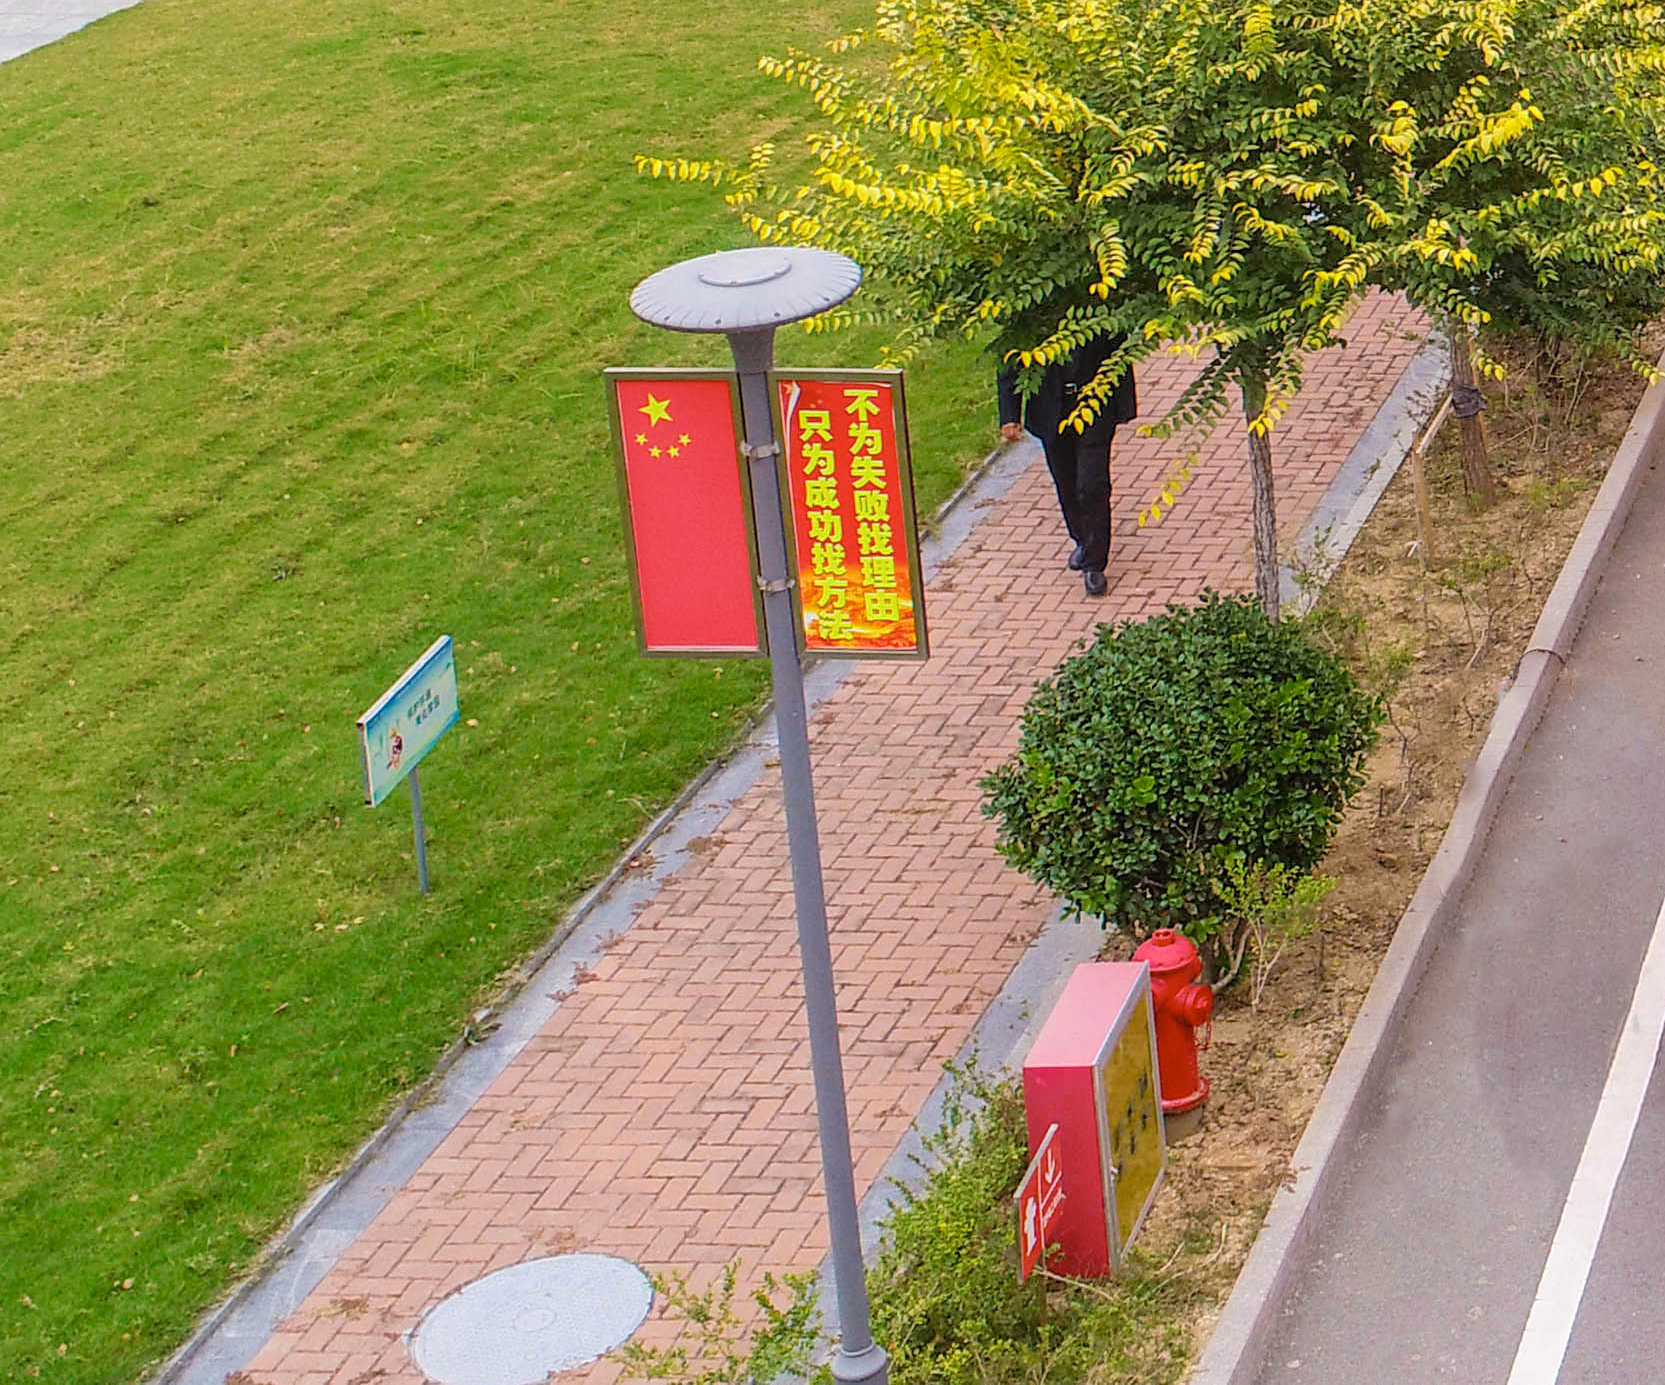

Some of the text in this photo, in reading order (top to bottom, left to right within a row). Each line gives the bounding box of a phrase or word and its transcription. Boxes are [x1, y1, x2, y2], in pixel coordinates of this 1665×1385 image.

[798, 409, 853, 641] 只为成功找方法
[843, 388, 900, 623] 不为失败找理由
